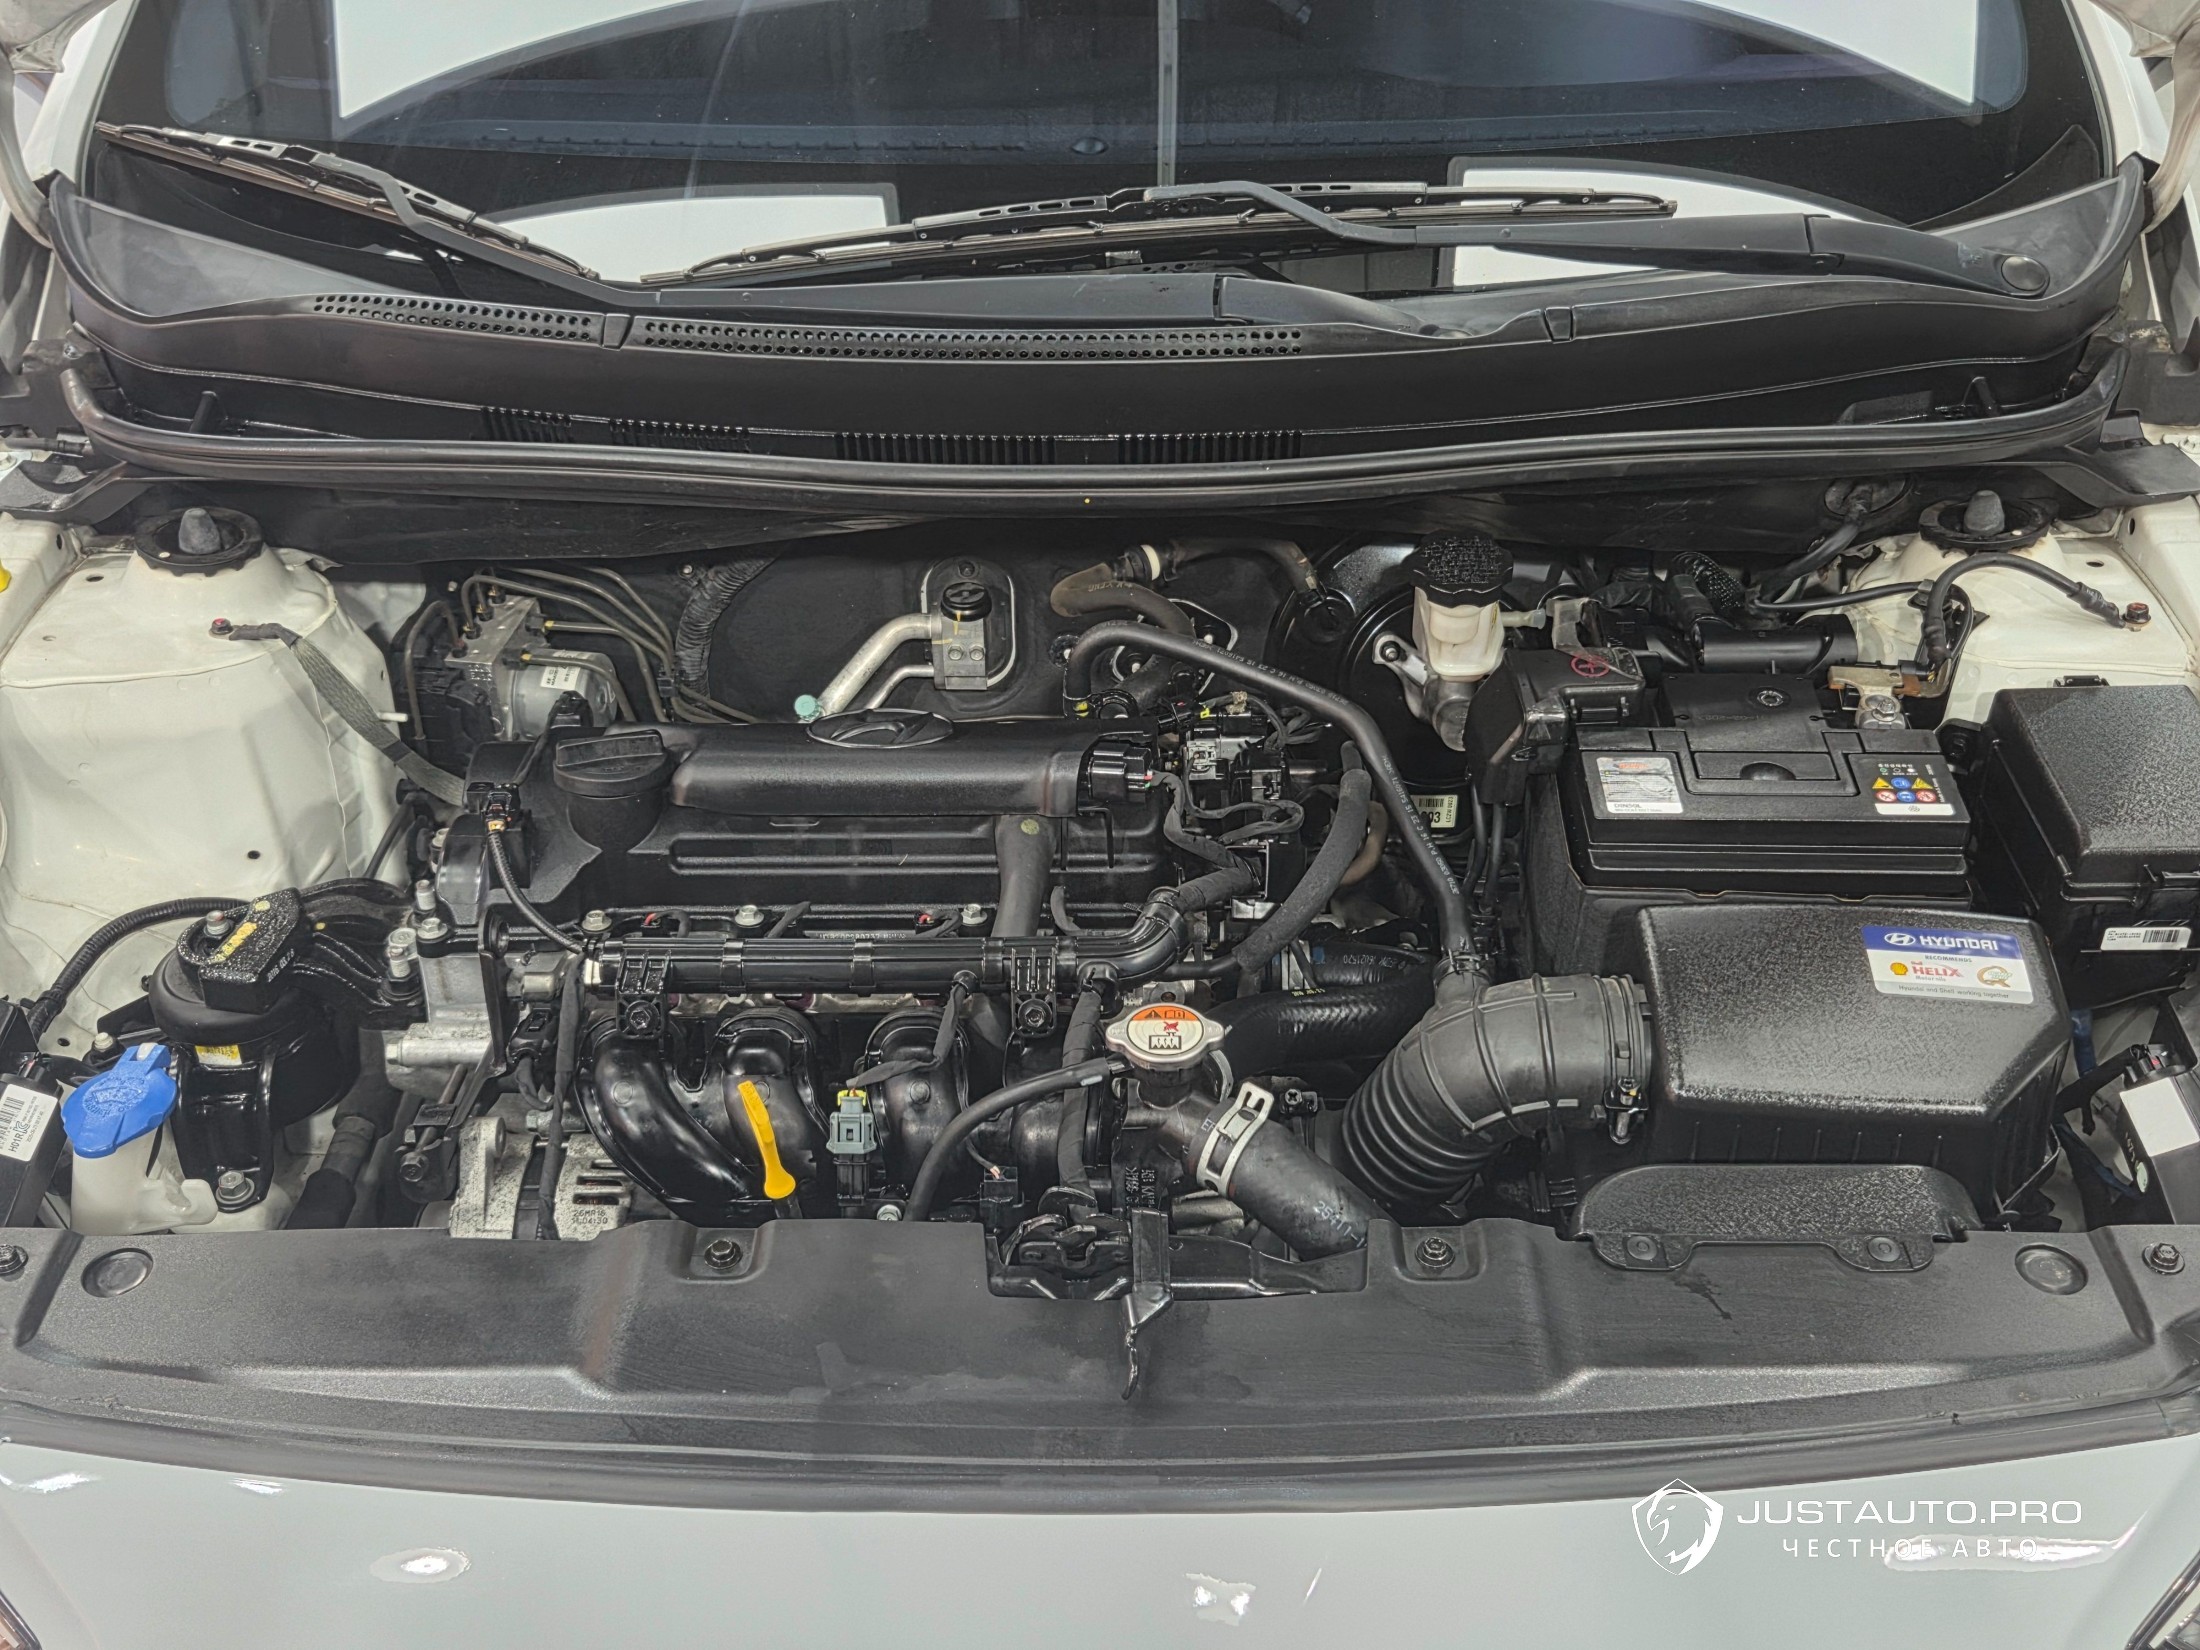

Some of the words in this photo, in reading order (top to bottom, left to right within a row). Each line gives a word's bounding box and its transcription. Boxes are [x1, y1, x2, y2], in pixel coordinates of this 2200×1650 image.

[1410, 814, 1420, 825] 23
[1919, 934, 1999, 951] HYUNDAI
[1912, 965, 1965, 978] HELIX
[1312, 1199, 1369, 1252] 25411-1
